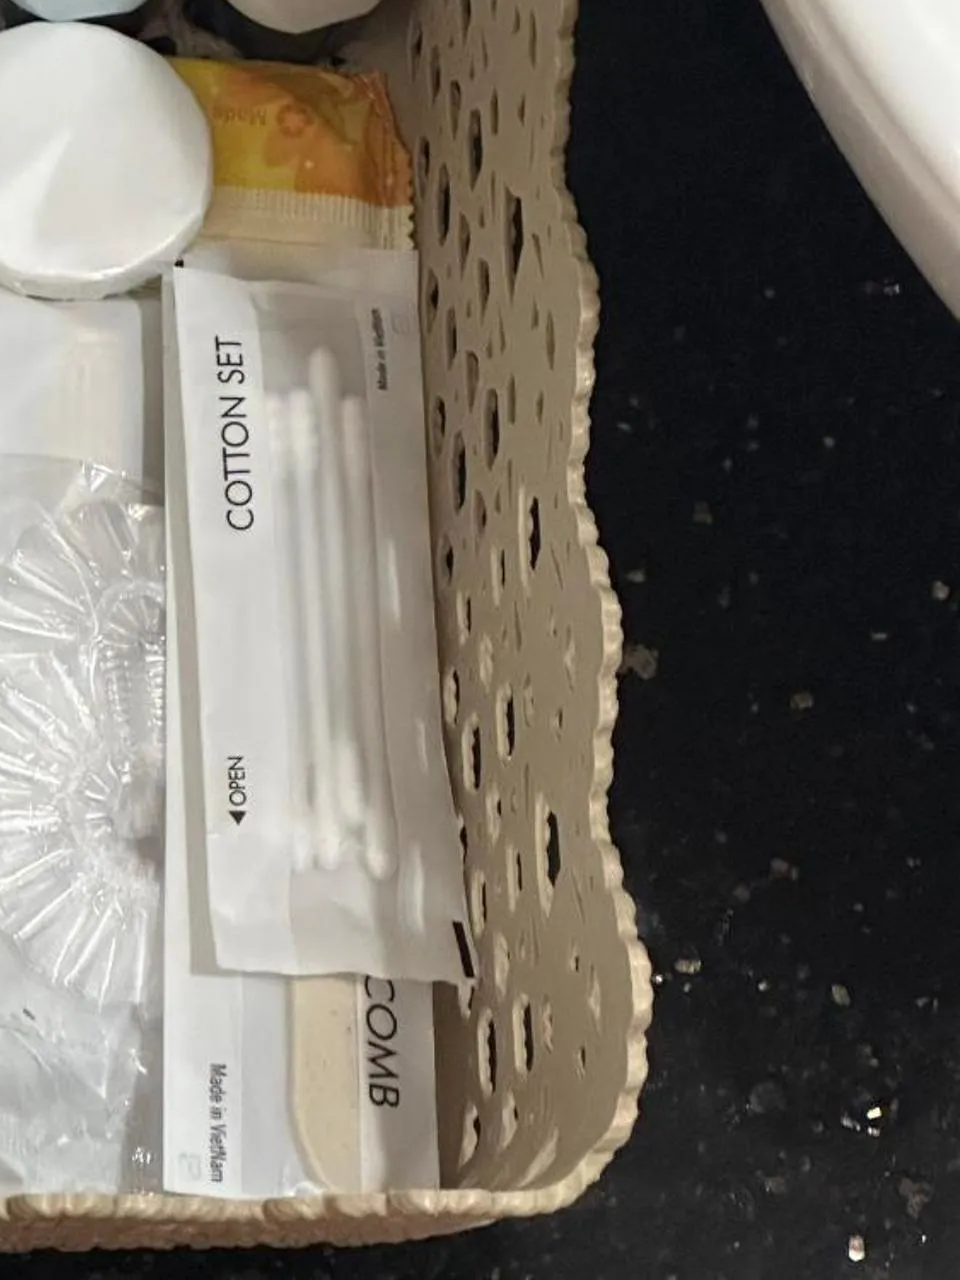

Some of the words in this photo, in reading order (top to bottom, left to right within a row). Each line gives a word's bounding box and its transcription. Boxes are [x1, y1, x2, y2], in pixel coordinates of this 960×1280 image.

[214, 335, 245, 385] SET
[218, 396, 255, 531] COTTON
[227, 755, 247, 806] OPEN
[365, 975, 400, 1109] COMB
[209, 1062, 228, 1103] Made
[210, 1105, 227, 1121] in
